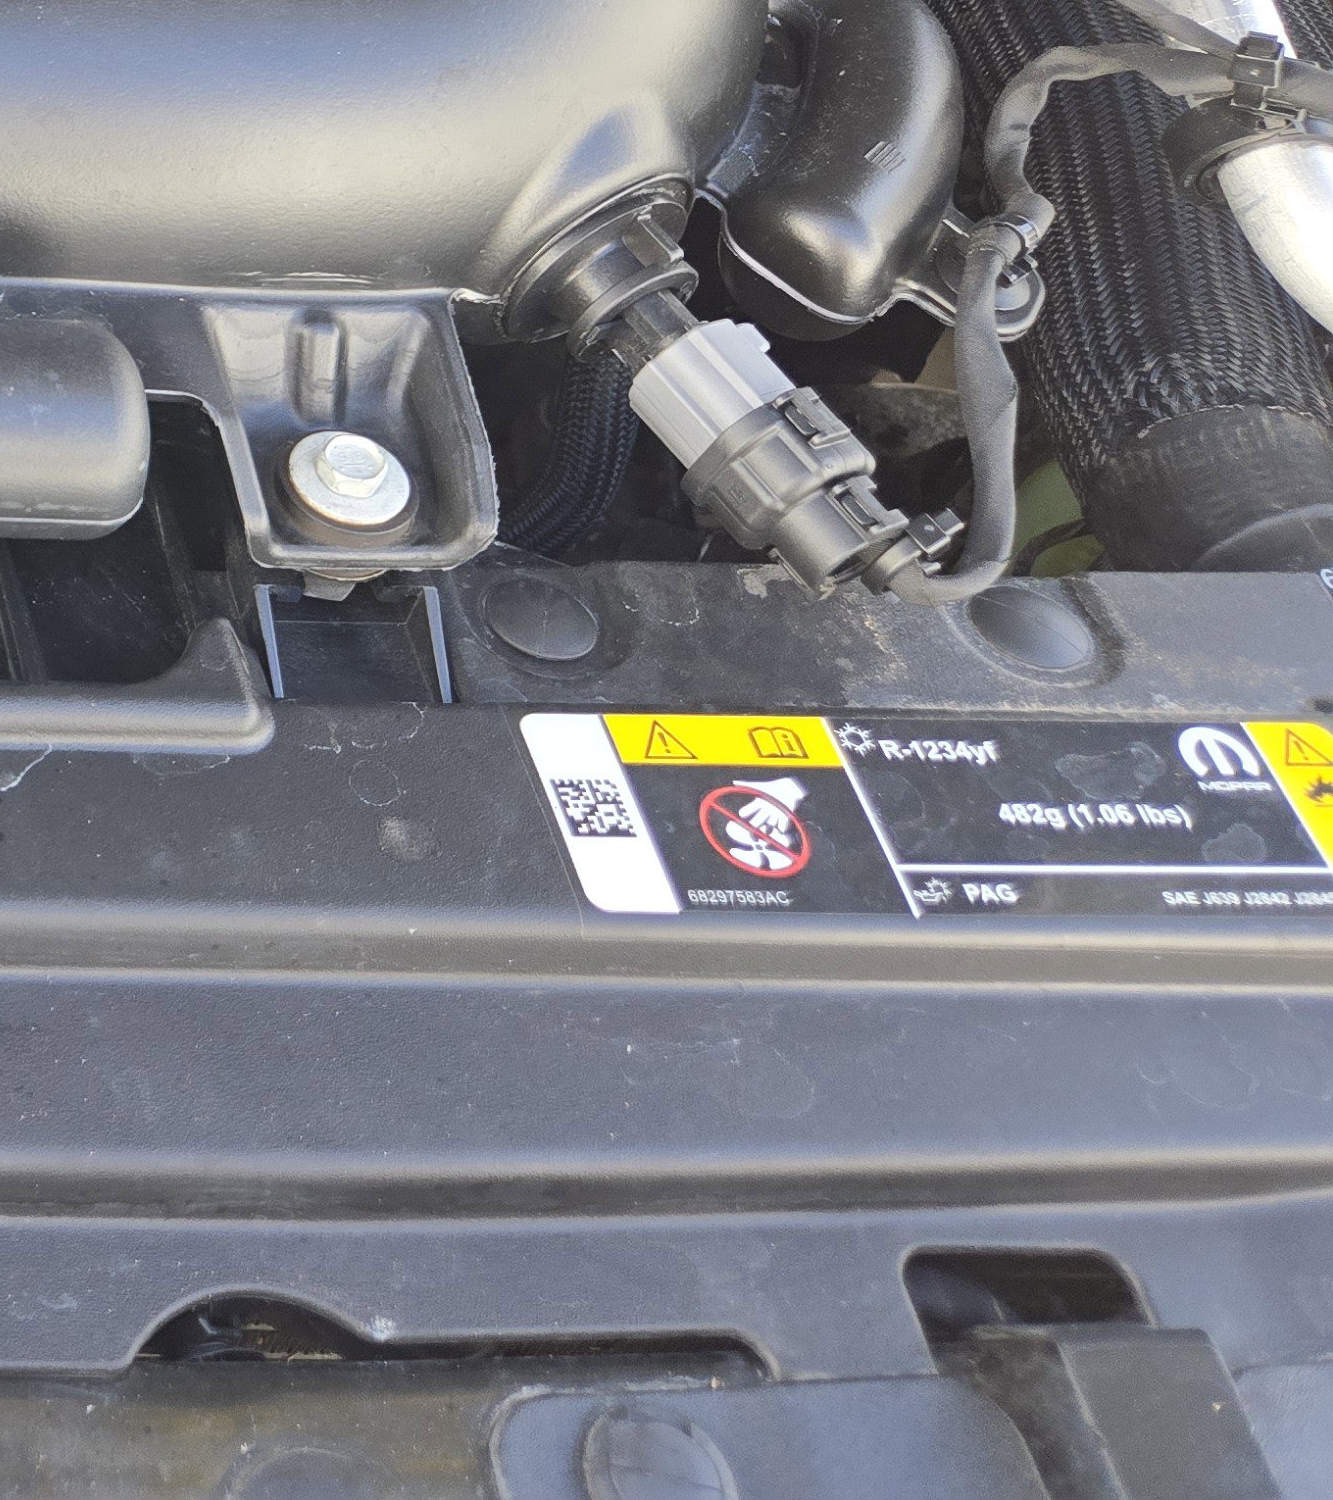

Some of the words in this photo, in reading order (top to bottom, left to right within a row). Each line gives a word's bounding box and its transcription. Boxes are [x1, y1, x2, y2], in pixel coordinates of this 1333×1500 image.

[880, 738, 1000, 765] R-1234yf
[1197, 780, 1274, 792] MOPAR
[999, 803, 1067, 830] 482g
[1067, 803, 1130, 832] (1.06
[1137, 803, 1194, 832] lbs)
[687, 889, 790, 906] 68297583AC
[962, 883, 1018, 905] PAG
[1162, 891, 1202, 906] SAE
